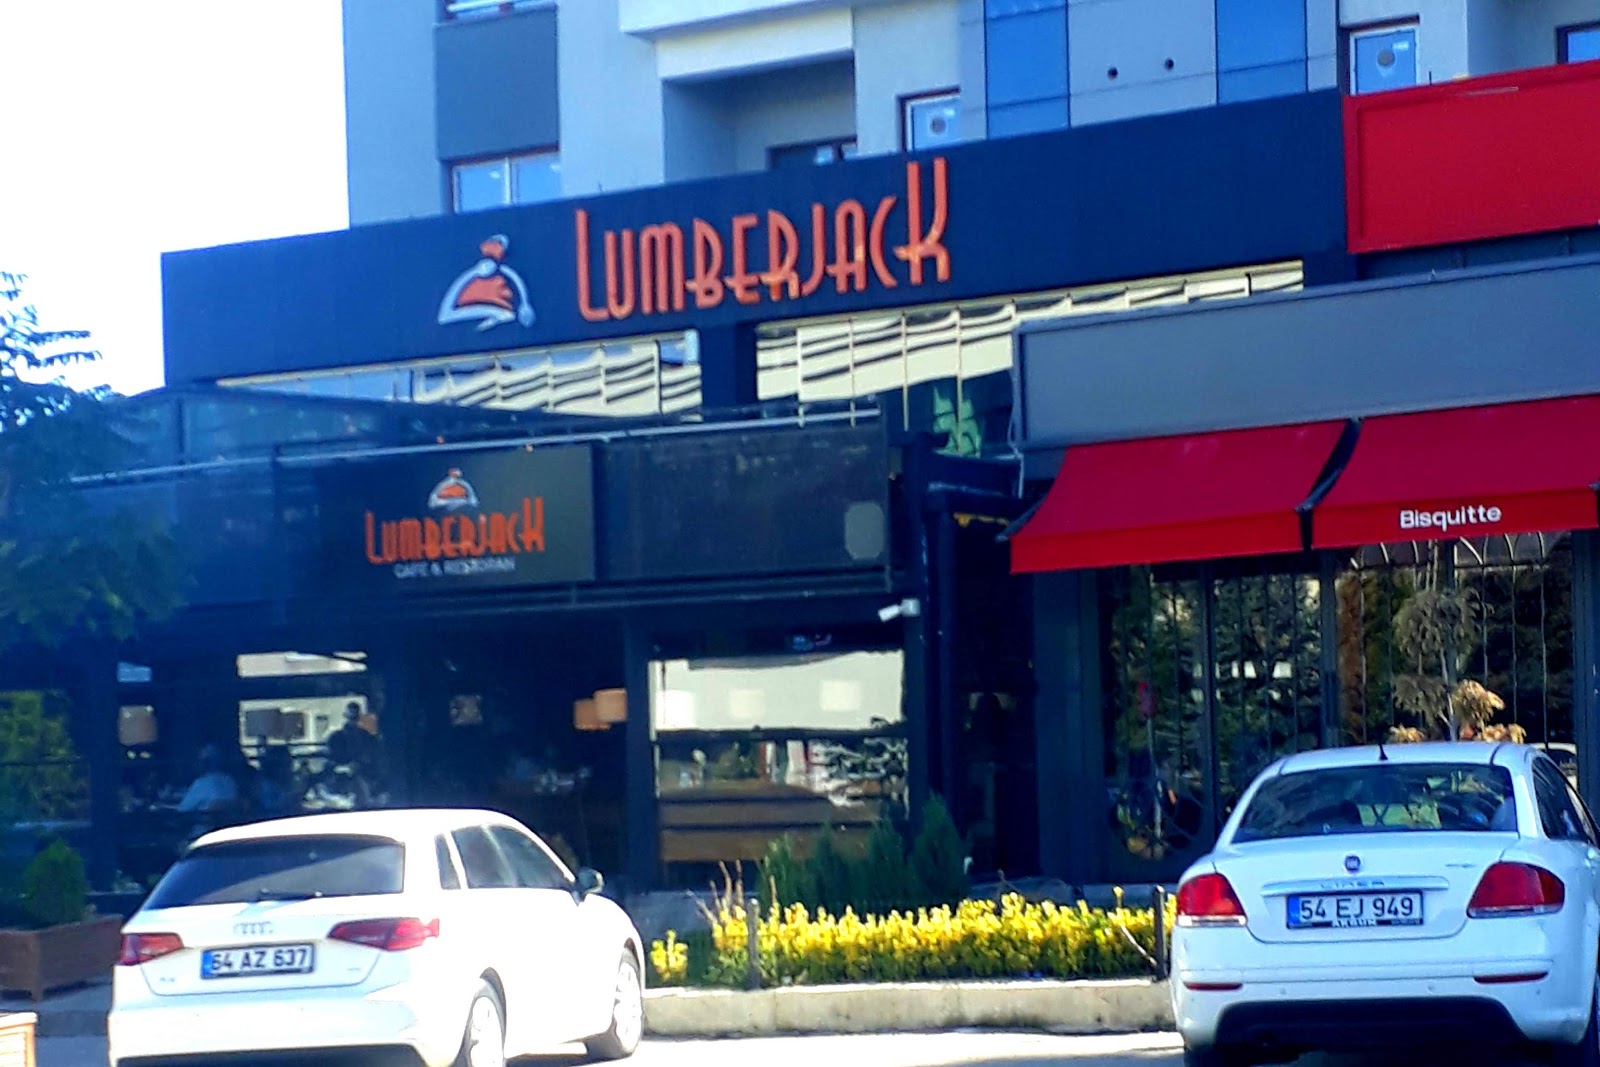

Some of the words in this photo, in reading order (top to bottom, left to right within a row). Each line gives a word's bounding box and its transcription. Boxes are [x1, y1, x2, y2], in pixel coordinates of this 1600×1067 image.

[575, 156, 951, 322] LUMBERJACK
[364, 496, 545, 565] LUMBERJACK
[1301, 899, 1326, 920] 54
[1336, 898, 1364, 919] EJ
[1373, 896, 1413, 918] 949
[240, 951, 268, 969] AZ
